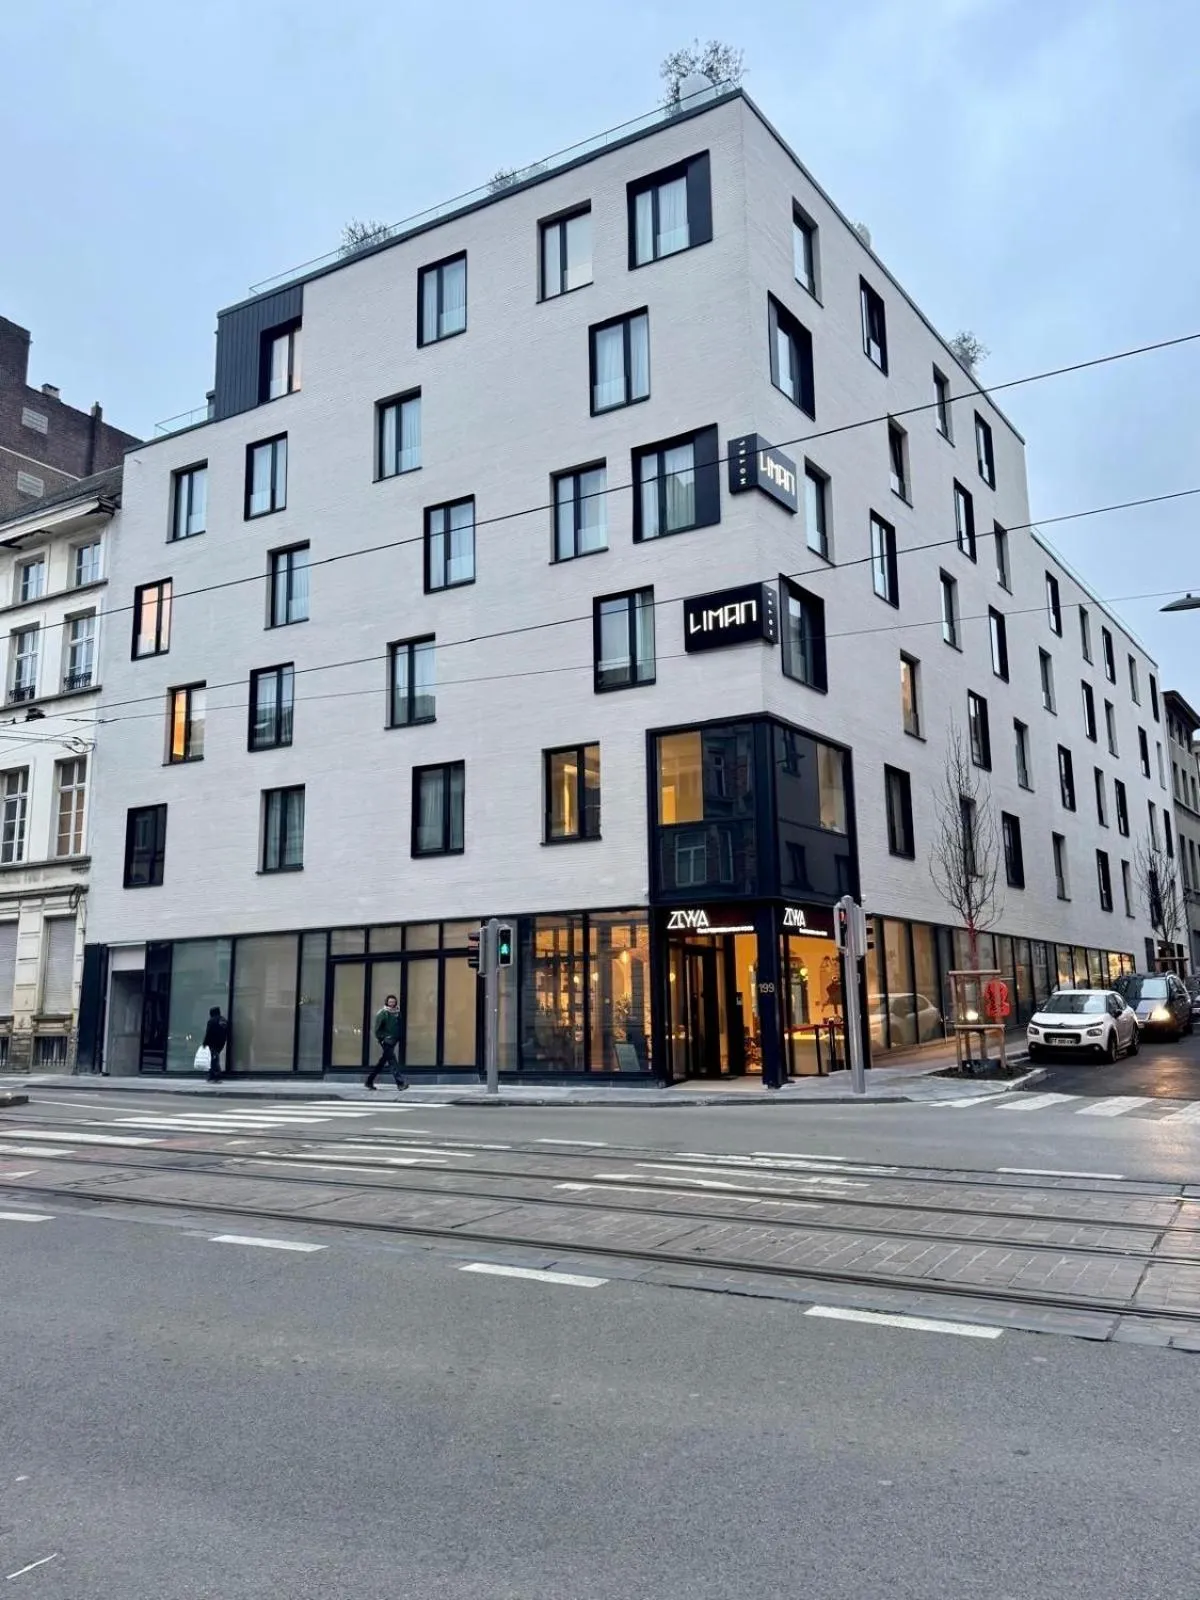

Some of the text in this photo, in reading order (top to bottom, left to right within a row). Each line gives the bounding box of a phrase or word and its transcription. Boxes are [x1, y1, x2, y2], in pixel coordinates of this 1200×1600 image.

[759, 450, 795, 496] LIMAN
[689, 599, 757, 635] LIMAN
[667, 909, 710, 929] ZIWA
[758, 982, 775, 993] 199
